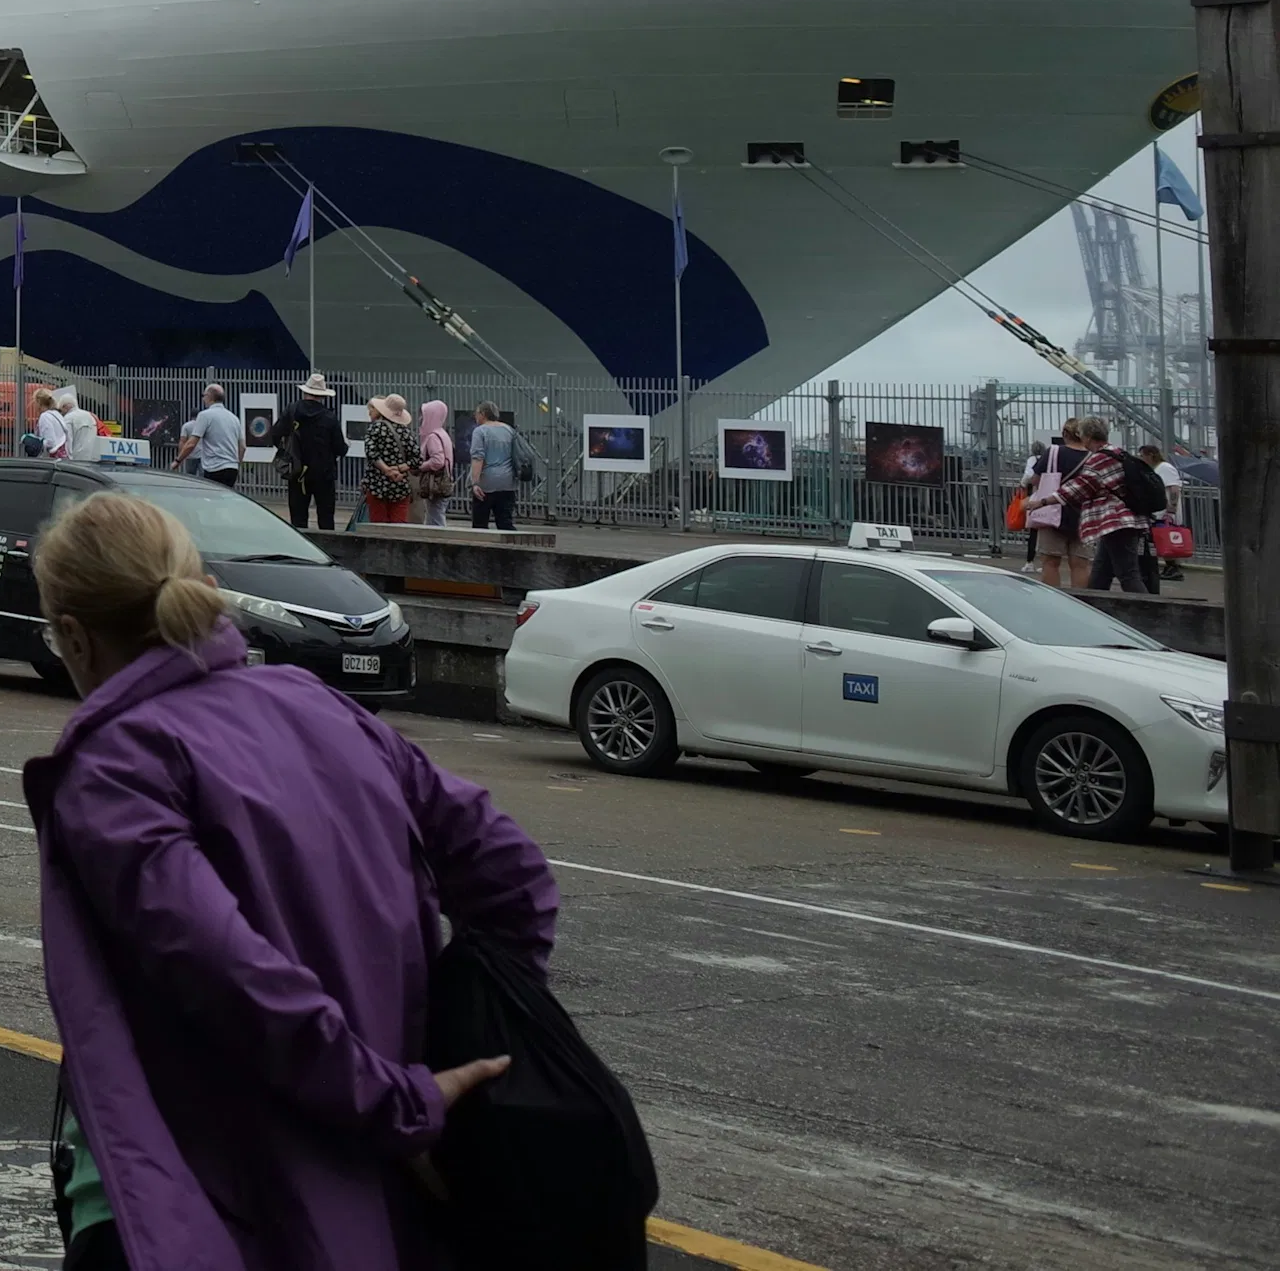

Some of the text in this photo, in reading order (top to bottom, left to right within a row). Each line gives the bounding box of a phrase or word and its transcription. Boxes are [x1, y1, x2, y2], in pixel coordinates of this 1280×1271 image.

[109, 440, 138, 455] TAXI
[876, 526, 899, 539] TAXI
[846, 680, 874, 697] TAXI
